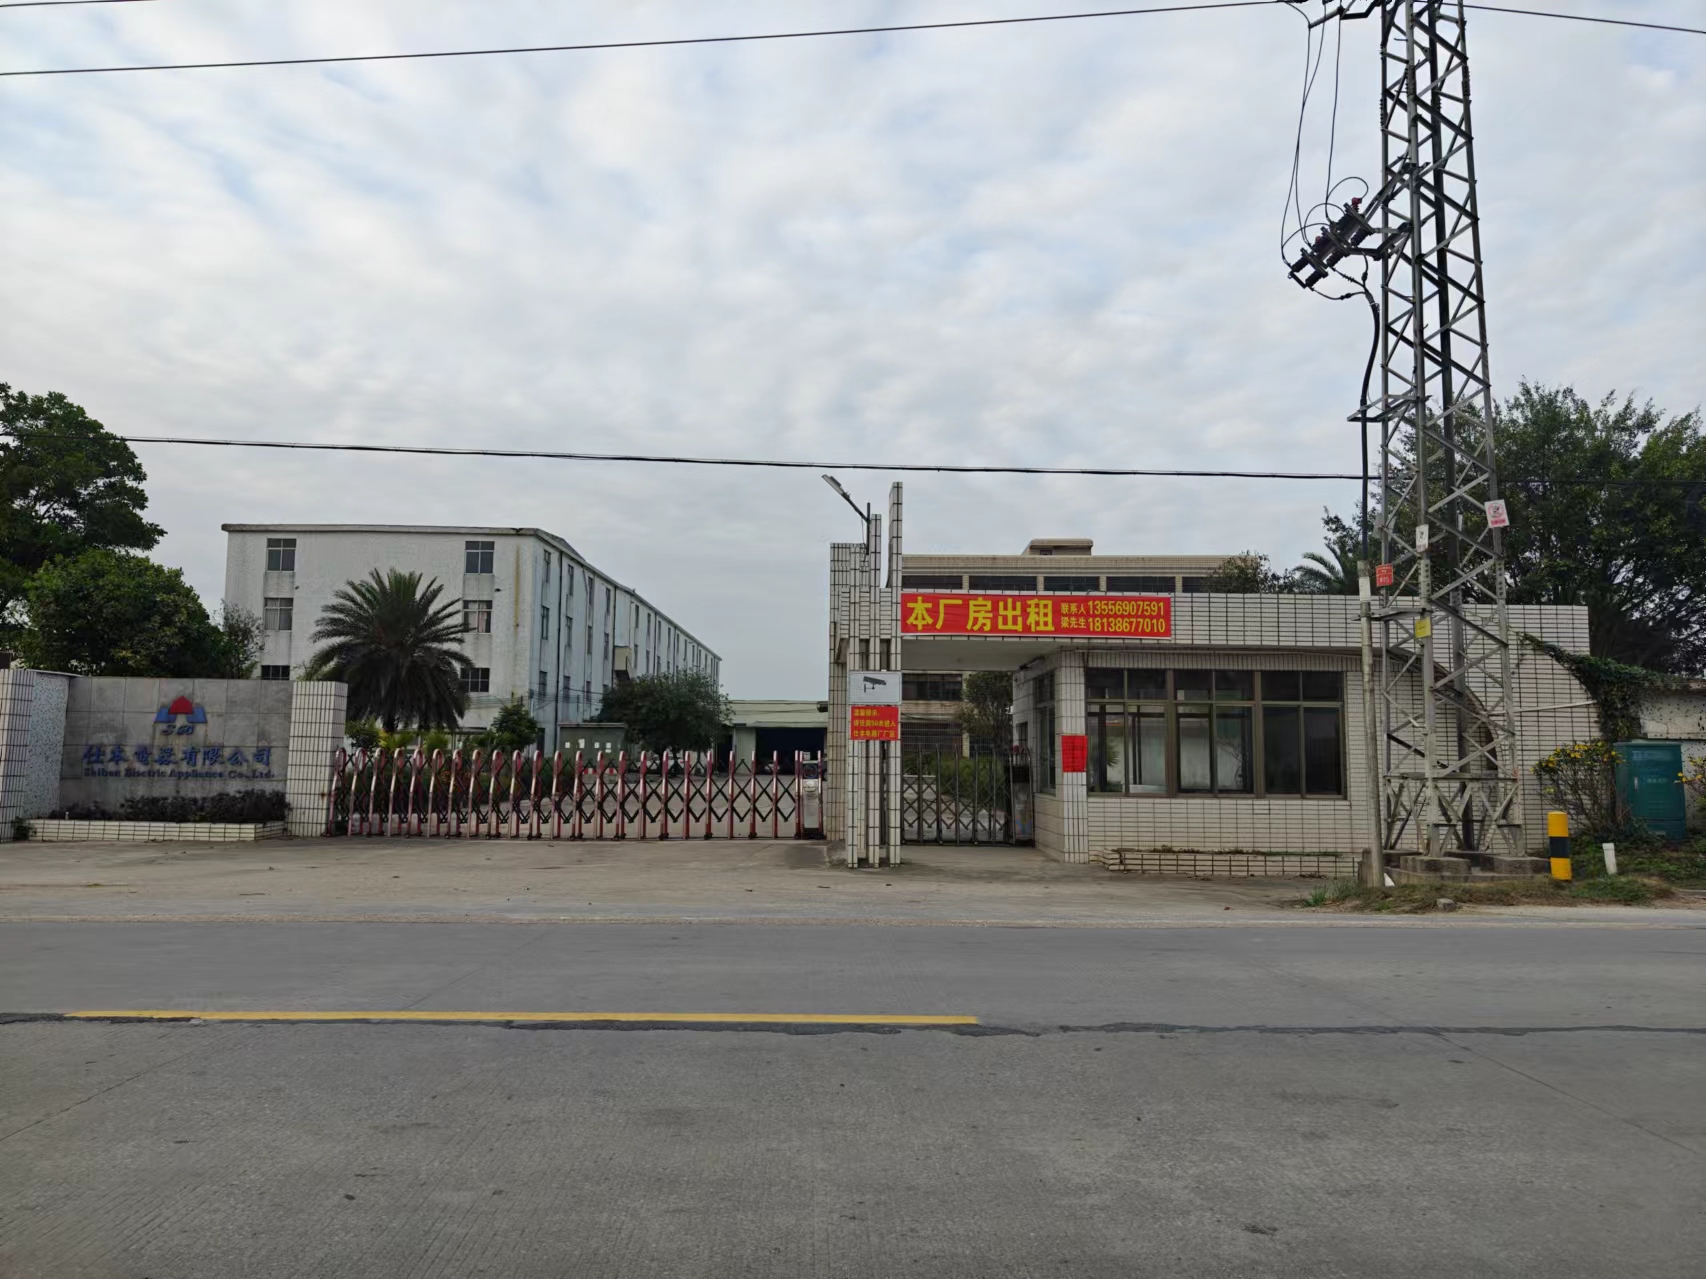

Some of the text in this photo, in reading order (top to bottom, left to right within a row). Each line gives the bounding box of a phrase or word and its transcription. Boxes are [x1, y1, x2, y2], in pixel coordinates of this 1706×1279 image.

[906, 596, 1054, 632] 本厂房出租
[1060, 600, 1165, 616] 联系人 13556907591
[1087, 617, 1166, 633] 18138677010
[169, 769, 224, 780] Appliance
